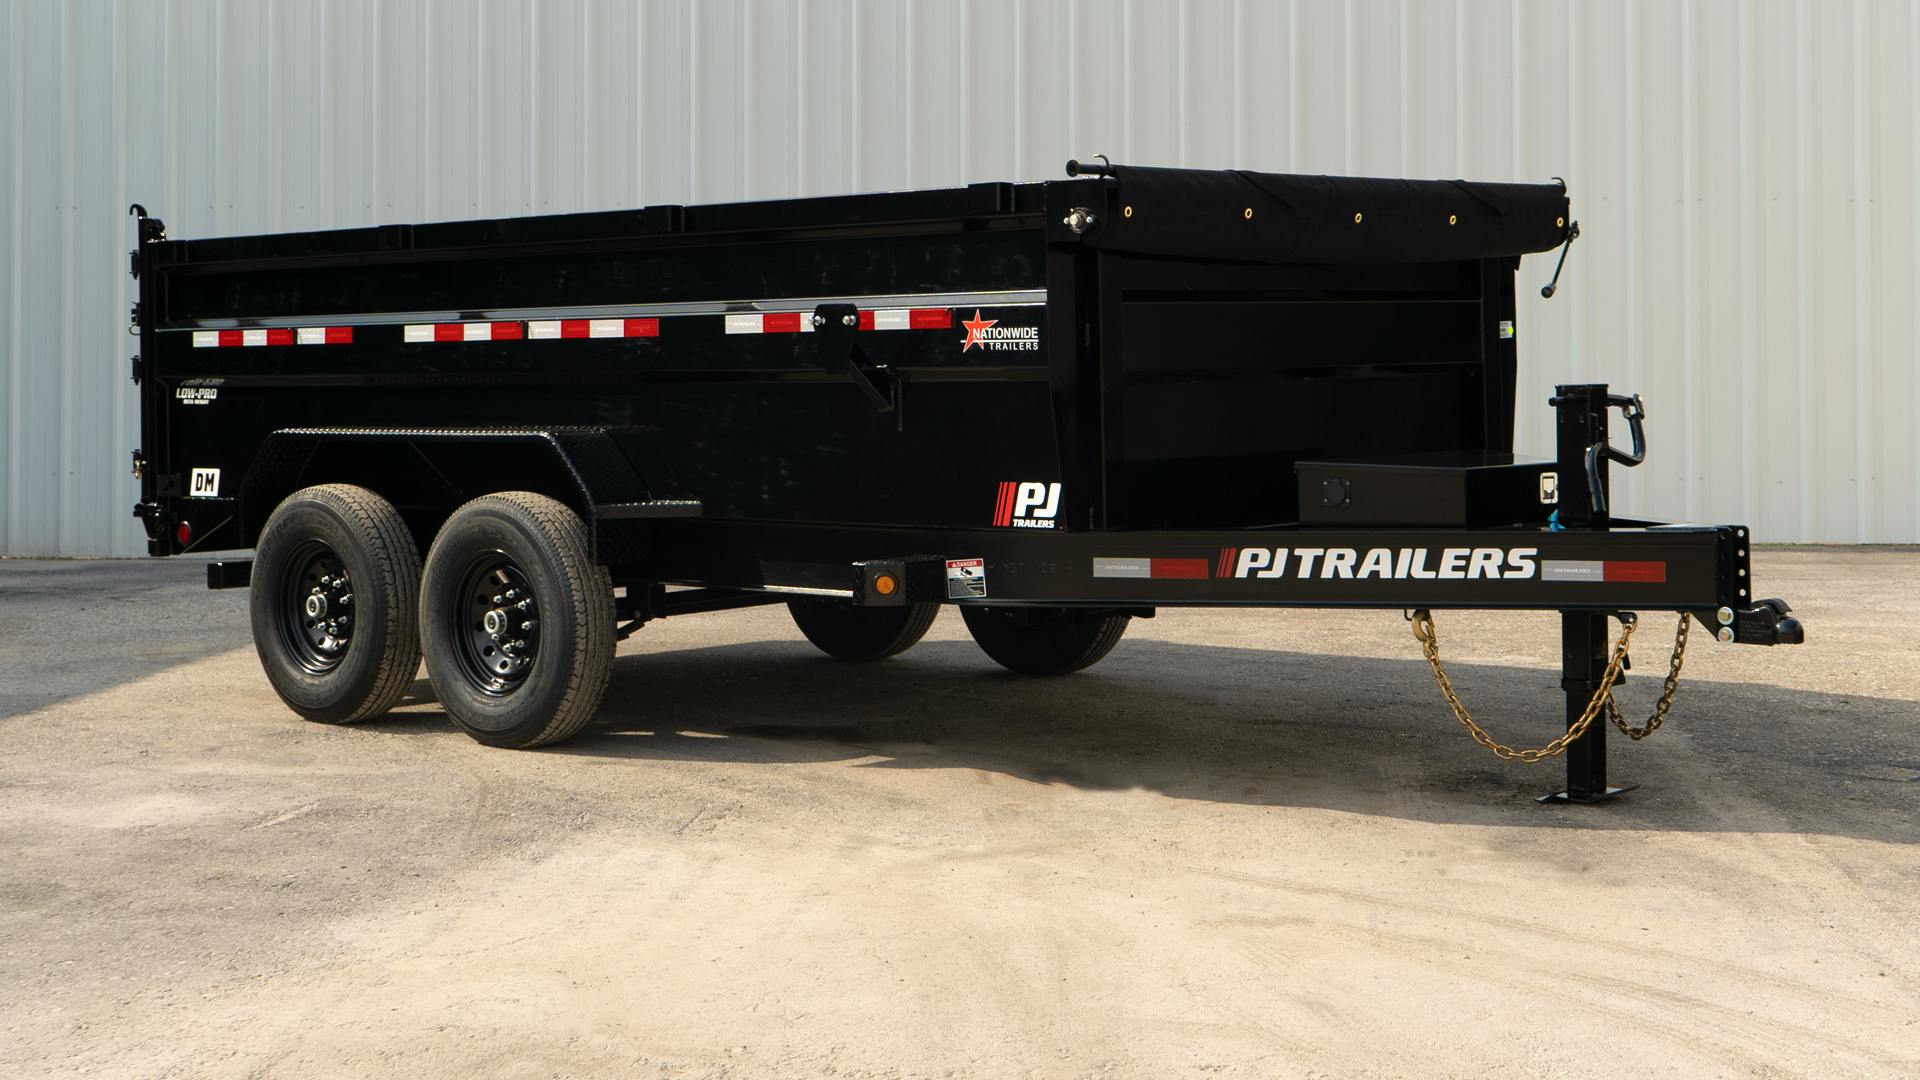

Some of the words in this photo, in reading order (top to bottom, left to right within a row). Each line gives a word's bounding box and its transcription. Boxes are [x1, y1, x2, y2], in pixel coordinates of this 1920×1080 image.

[973, 327, 1039, 339] NATIONWIDE
[990, 342, 1039, 351] TRAILERS
[176, 387, 218, 399] LOW-PRO
[195, 472, 216, 492] DM
[1014, 482, 1062, 518] PJ
[1013, 519, 1055, 529] TRAILERS
[956, 560, 978, 568] DANGER
[1235, 547, 1289, 579] PJ
[1293, 547, 1538, 579] TRAILERS
